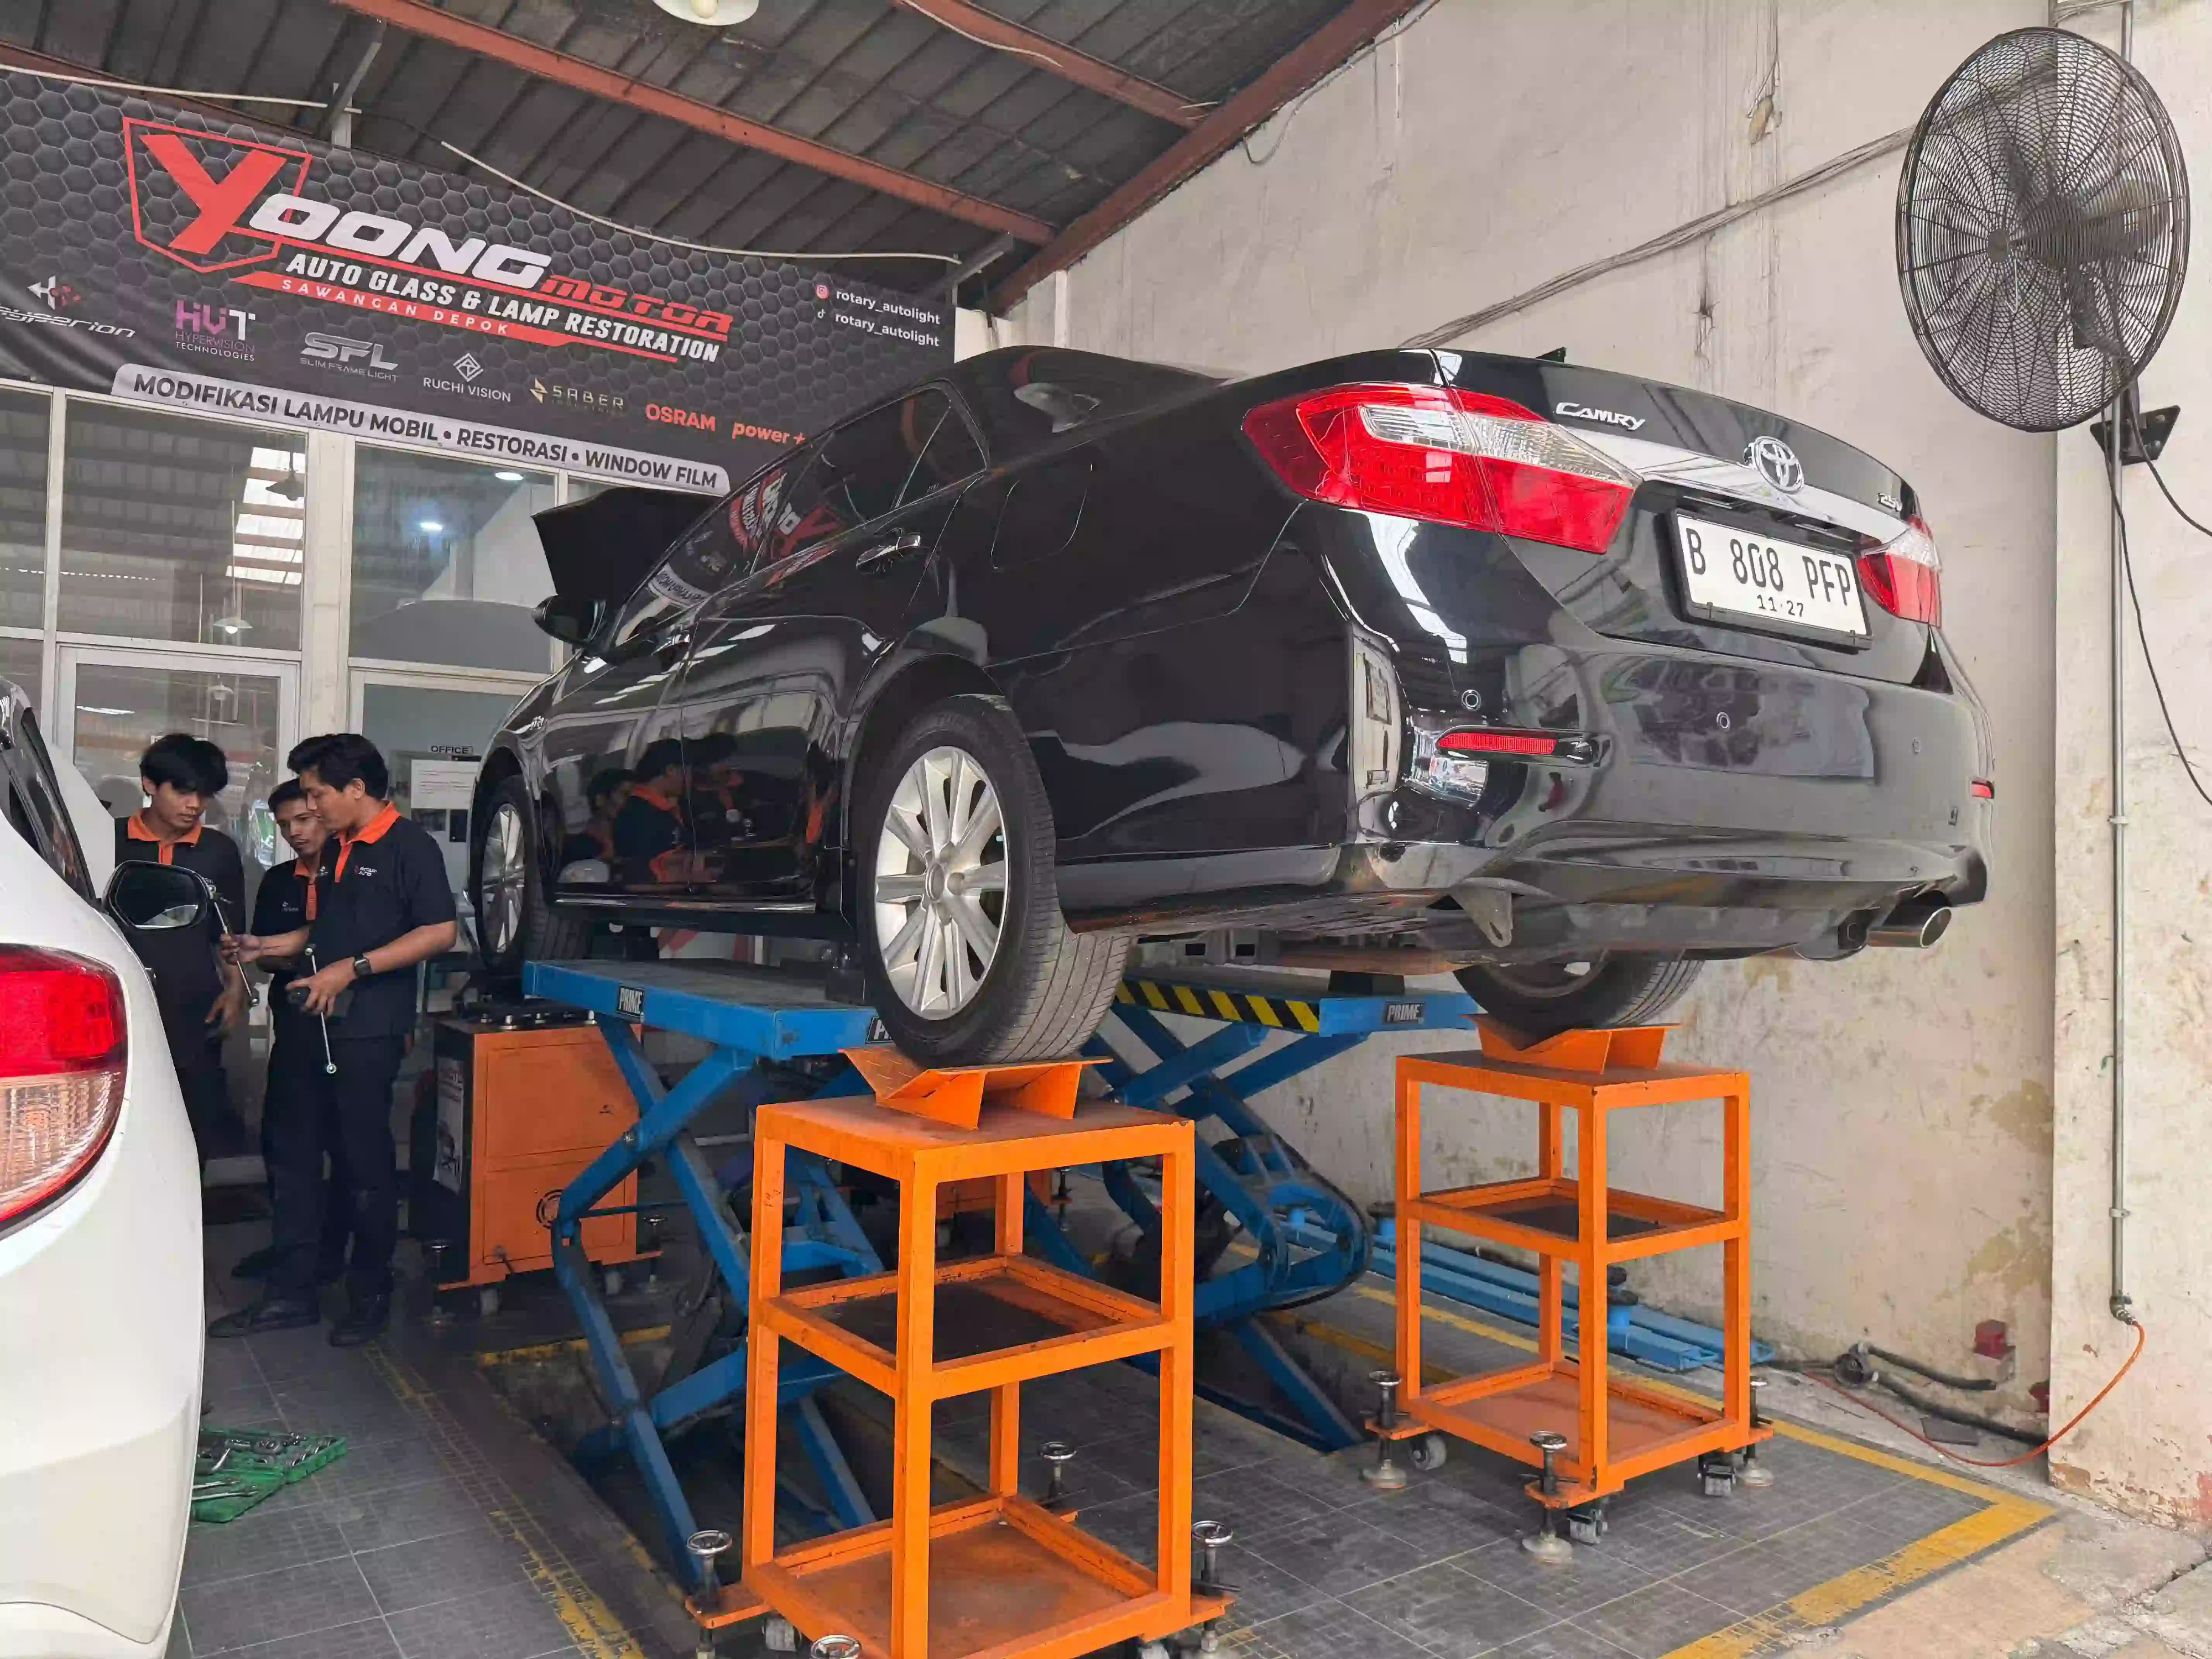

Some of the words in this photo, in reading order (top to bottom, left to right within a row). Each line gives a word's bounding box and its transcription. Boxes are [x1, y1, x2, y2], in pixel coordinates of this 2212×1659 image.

[139, 135, 552, 289] YOONG
[281, 279, 418, 316] SAWANGAN
[434, 310, 509, 335] DEPOK
[286, 254, 363, 285] AUTO
[369, 270, 456, 306] GLASS
[462, 290, 481, 310] &
[488, 296, 560, 326] LAMP
[565, 314, 719, 362] RESTORATION
[540, 274, 734, 333] MOTOR
[836, 290, 940, 325] rotary_autolight
[175, 331, 255, 354] HYPERVISION
[835, 314, 939, 347] rotary_autolight
[176, 341, 254, 361] TECHNOLOGIES
[301, 332, 398, 371] SFL
[300, 357, 326, 369] SLIM
[328, 362, 365, 375] FRAME
[367, 370, 398, 382] LIGHT
[423, 377, 464, 394] RUCHI
[467, 385, 511, 403] VISION
[552, 385, 624, 409] SABER
[645, 404, 716, 431] OSRAM
[1556, 402, 1646, 430] CAMRY
[133, 374, 277, 414] MODIFIKASI
[284, 399, 364, 428] LAMPU
[370, 414, 439, 441] MOBIL
[457, 428, 567, 462] RESTORASI
[586, 450, 672, 479] WINDOW
[676, 466, 717, 488] FILM
[1686, 528, 1706, 575] B
[1730, 539, 1783, 592] 808
[1802, 556, 1851, 606] PFP
[431, 745, 468, 754] OFFICE
[619, 988, 642, 1014] PRIME
[1387, 1004, 1420, 1022] PRIME
